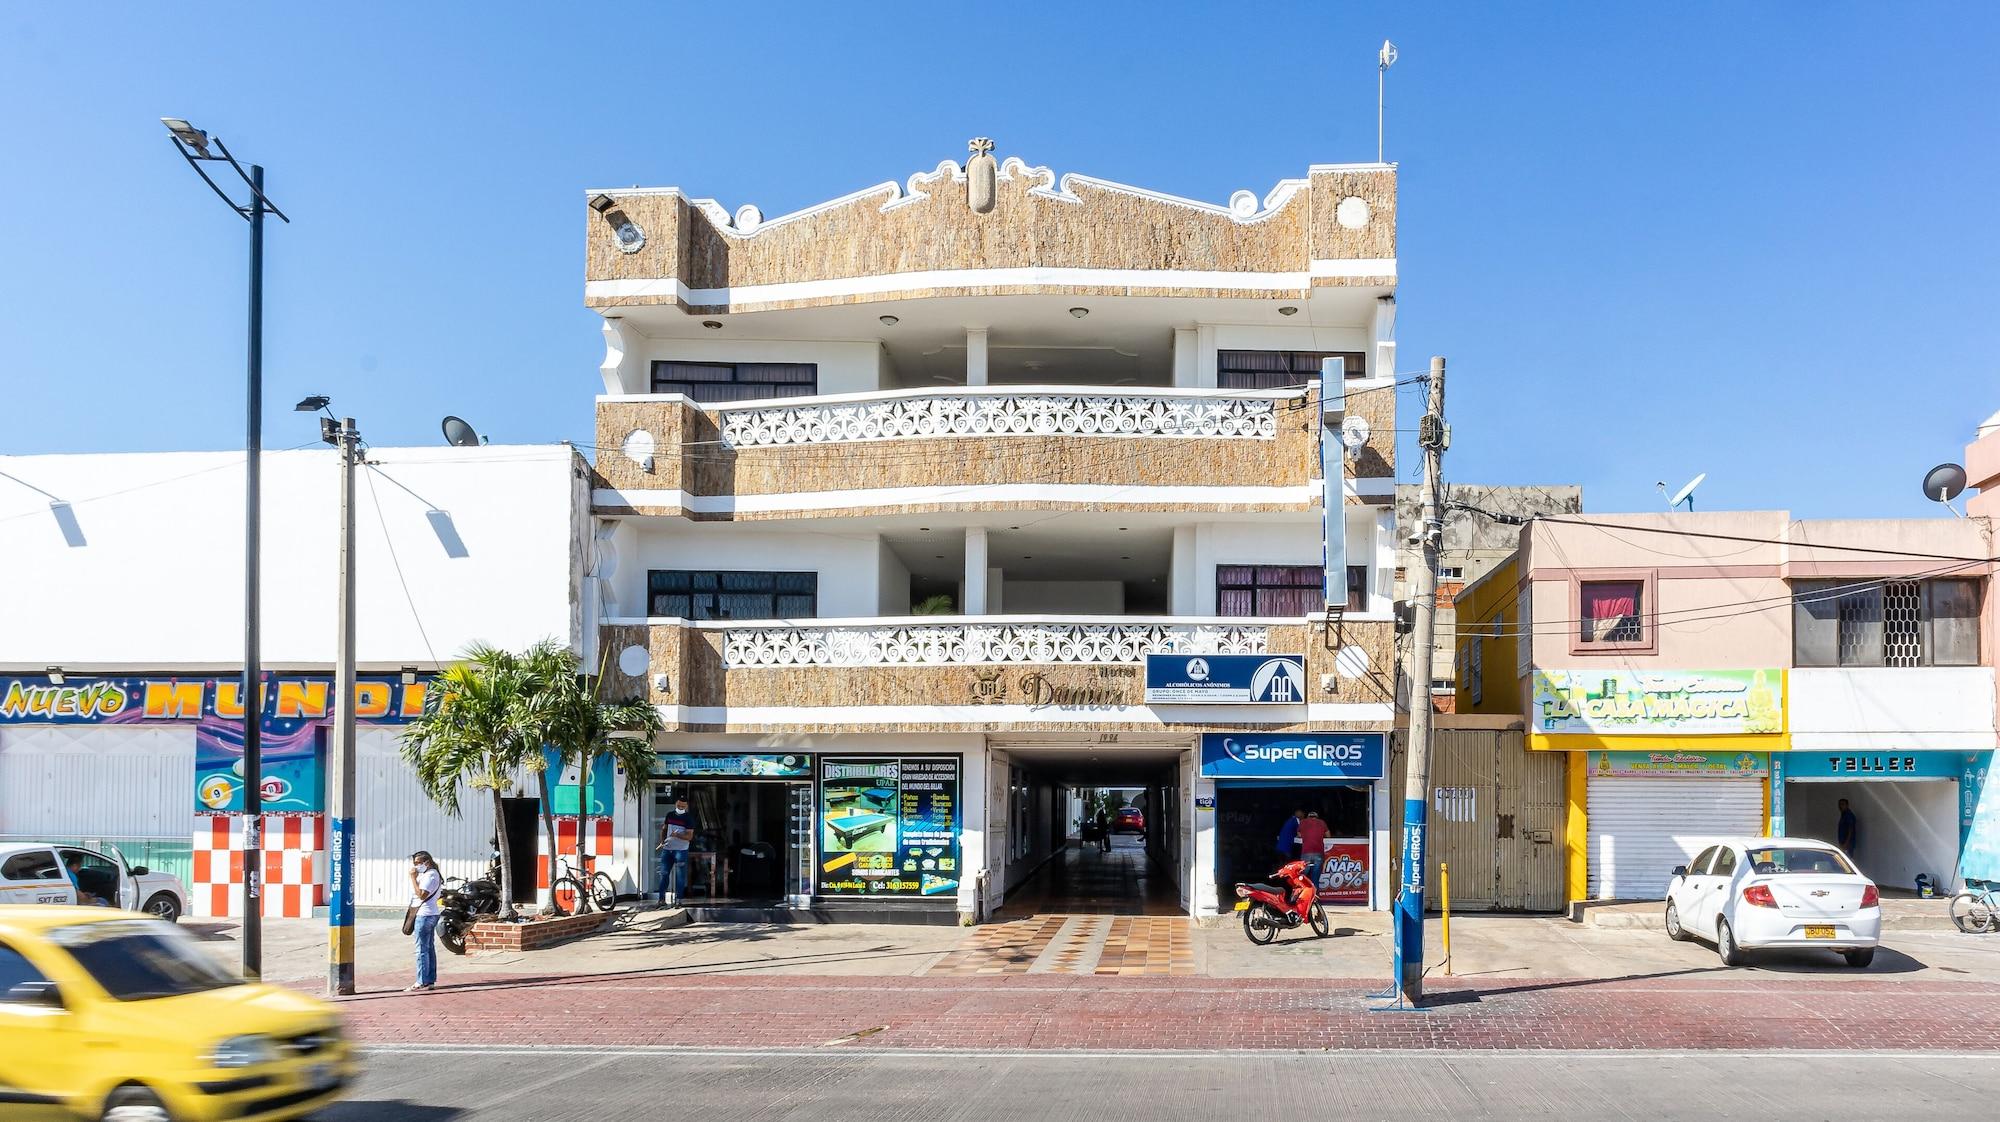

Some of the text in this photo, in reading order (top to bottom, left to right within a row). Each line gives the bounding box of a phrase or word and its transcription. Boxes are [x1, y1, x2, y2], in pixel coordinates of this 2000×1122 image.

[1, 681, 462, 719] NUEVO MUNDI
[1551, 698, 1581, 719] LA
[1586, 698, 1648, 719] CASA
[1245, 744, 1363, 763] Super GIROS
[824, 764, 898, 778] DISTRIBILLARES
[1200, 797, 1213, 807] tigo
[332, 830, 343, 892] Super GIROS
[1326, 858, 1361, 872] ÑAPA
[1410, 826, 1421, 893] Super GIROS
[873, 881, 885, 889] Cel:
[1319, 872, 1362, 889] 50%
